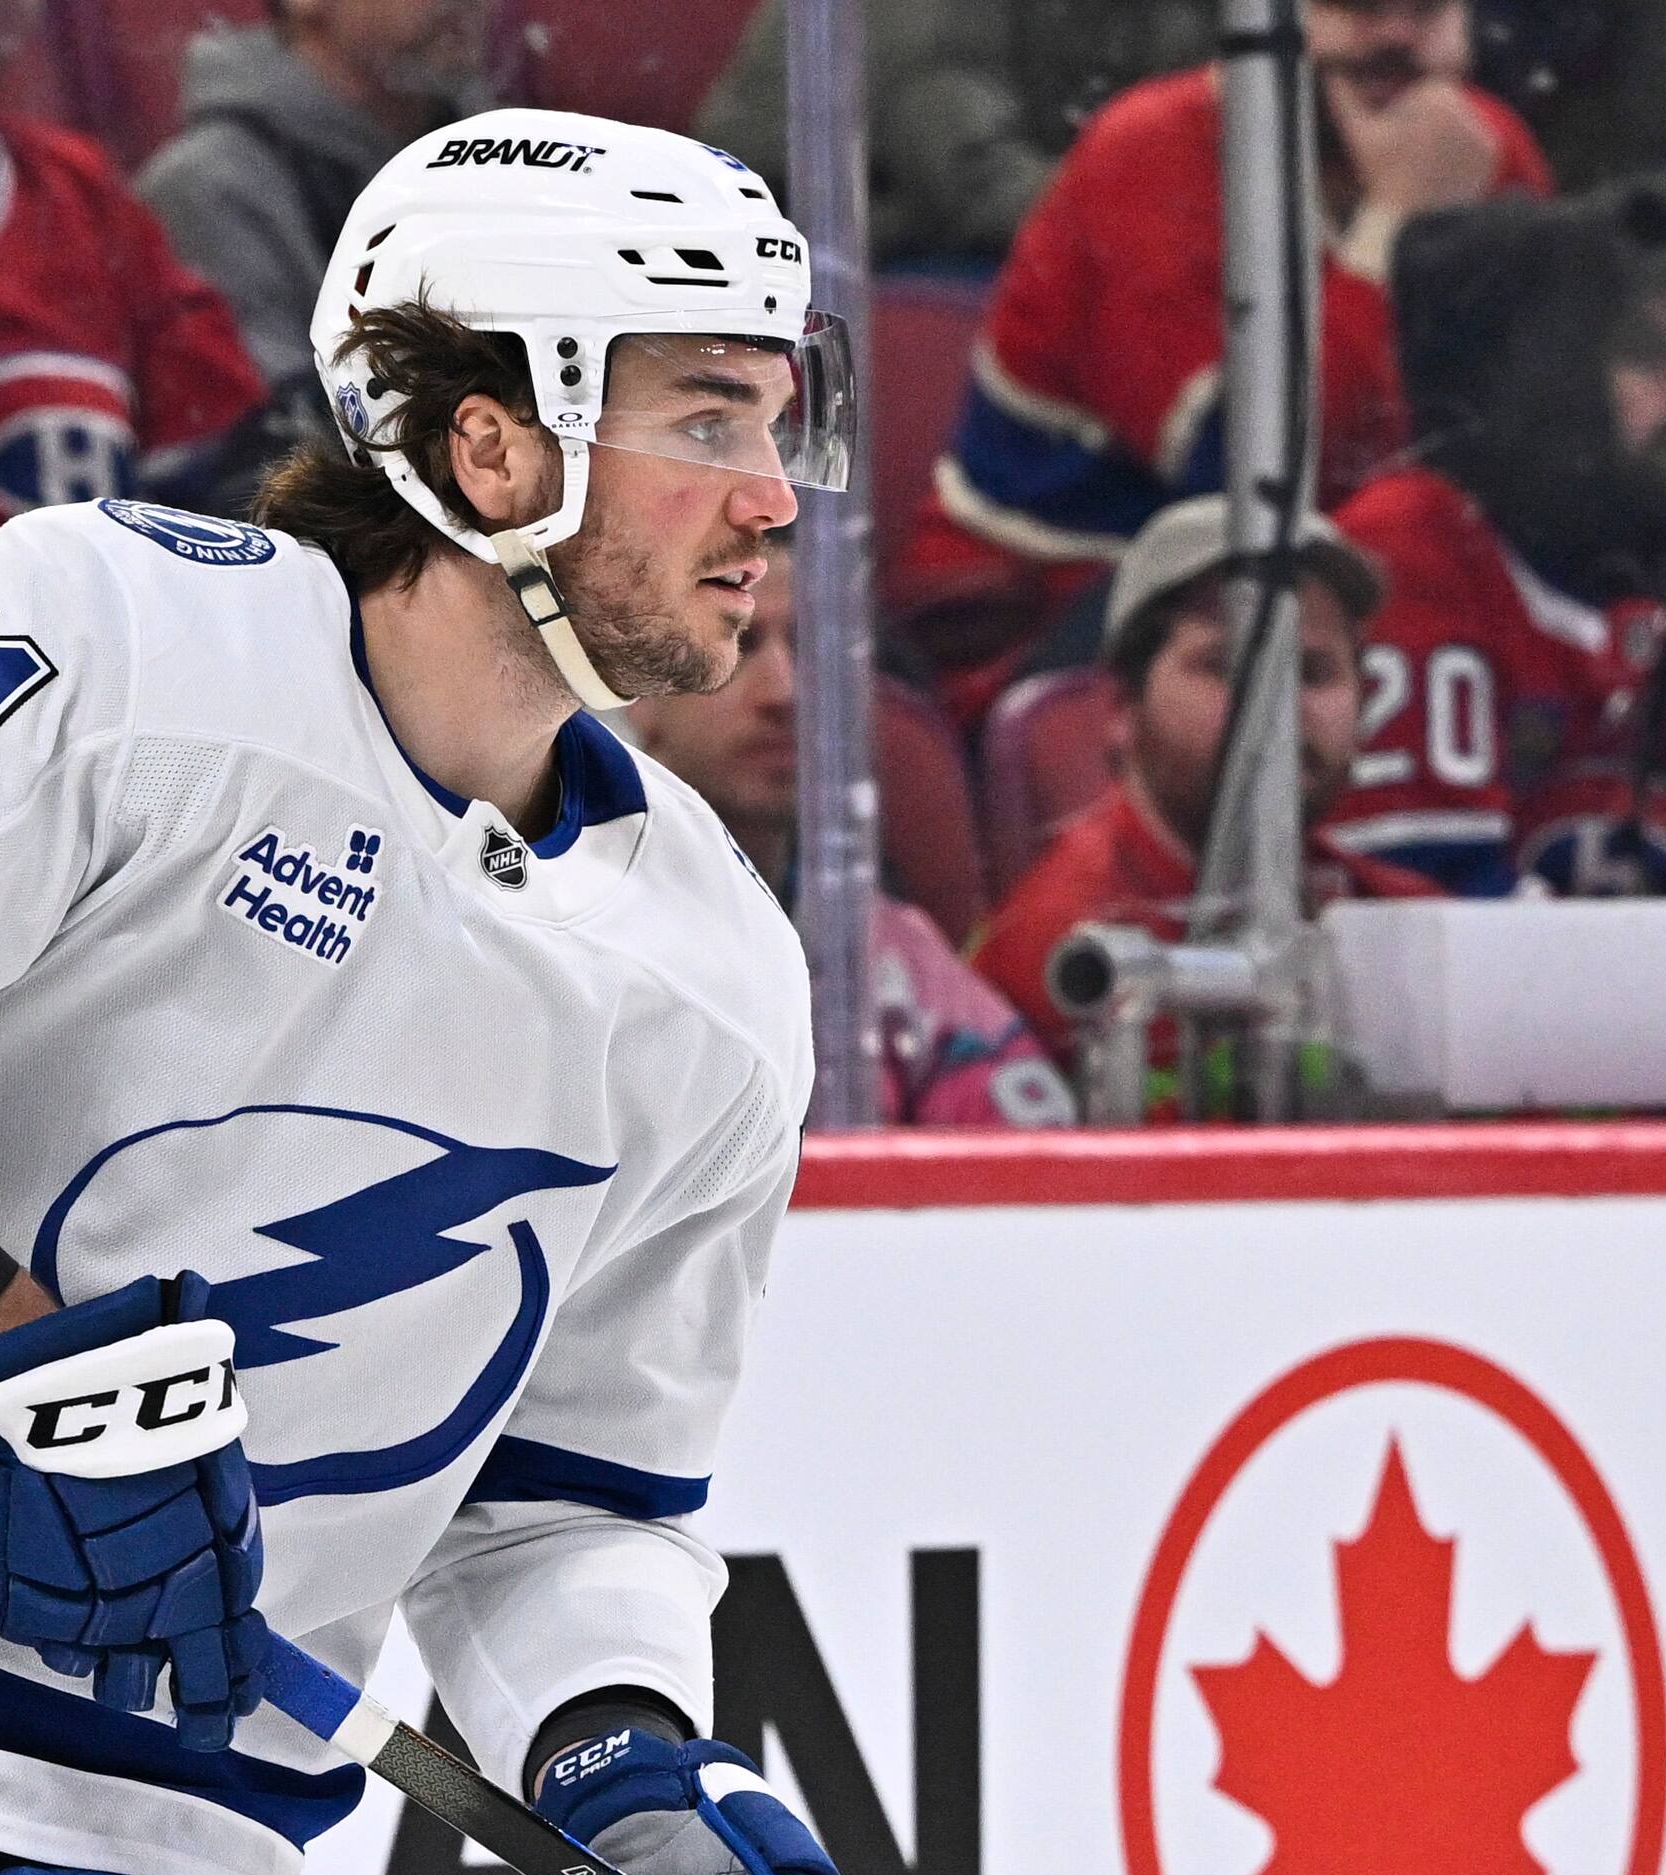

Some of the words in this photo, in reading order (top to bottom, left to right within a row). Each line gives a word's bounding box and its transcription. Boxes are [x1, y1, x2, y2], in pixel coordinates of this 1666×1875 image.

[426, 139, 607, 172] BRANDT
[1348, 643, 1497, 788] 20
[239, 833, 376, 922] Advent
[489, 852, 523, 872] NHL
[224, 875, 352, 965] Health
[554, 1729, 631, 1780] CCM
[580, 1757, 612, 1780] PRO
